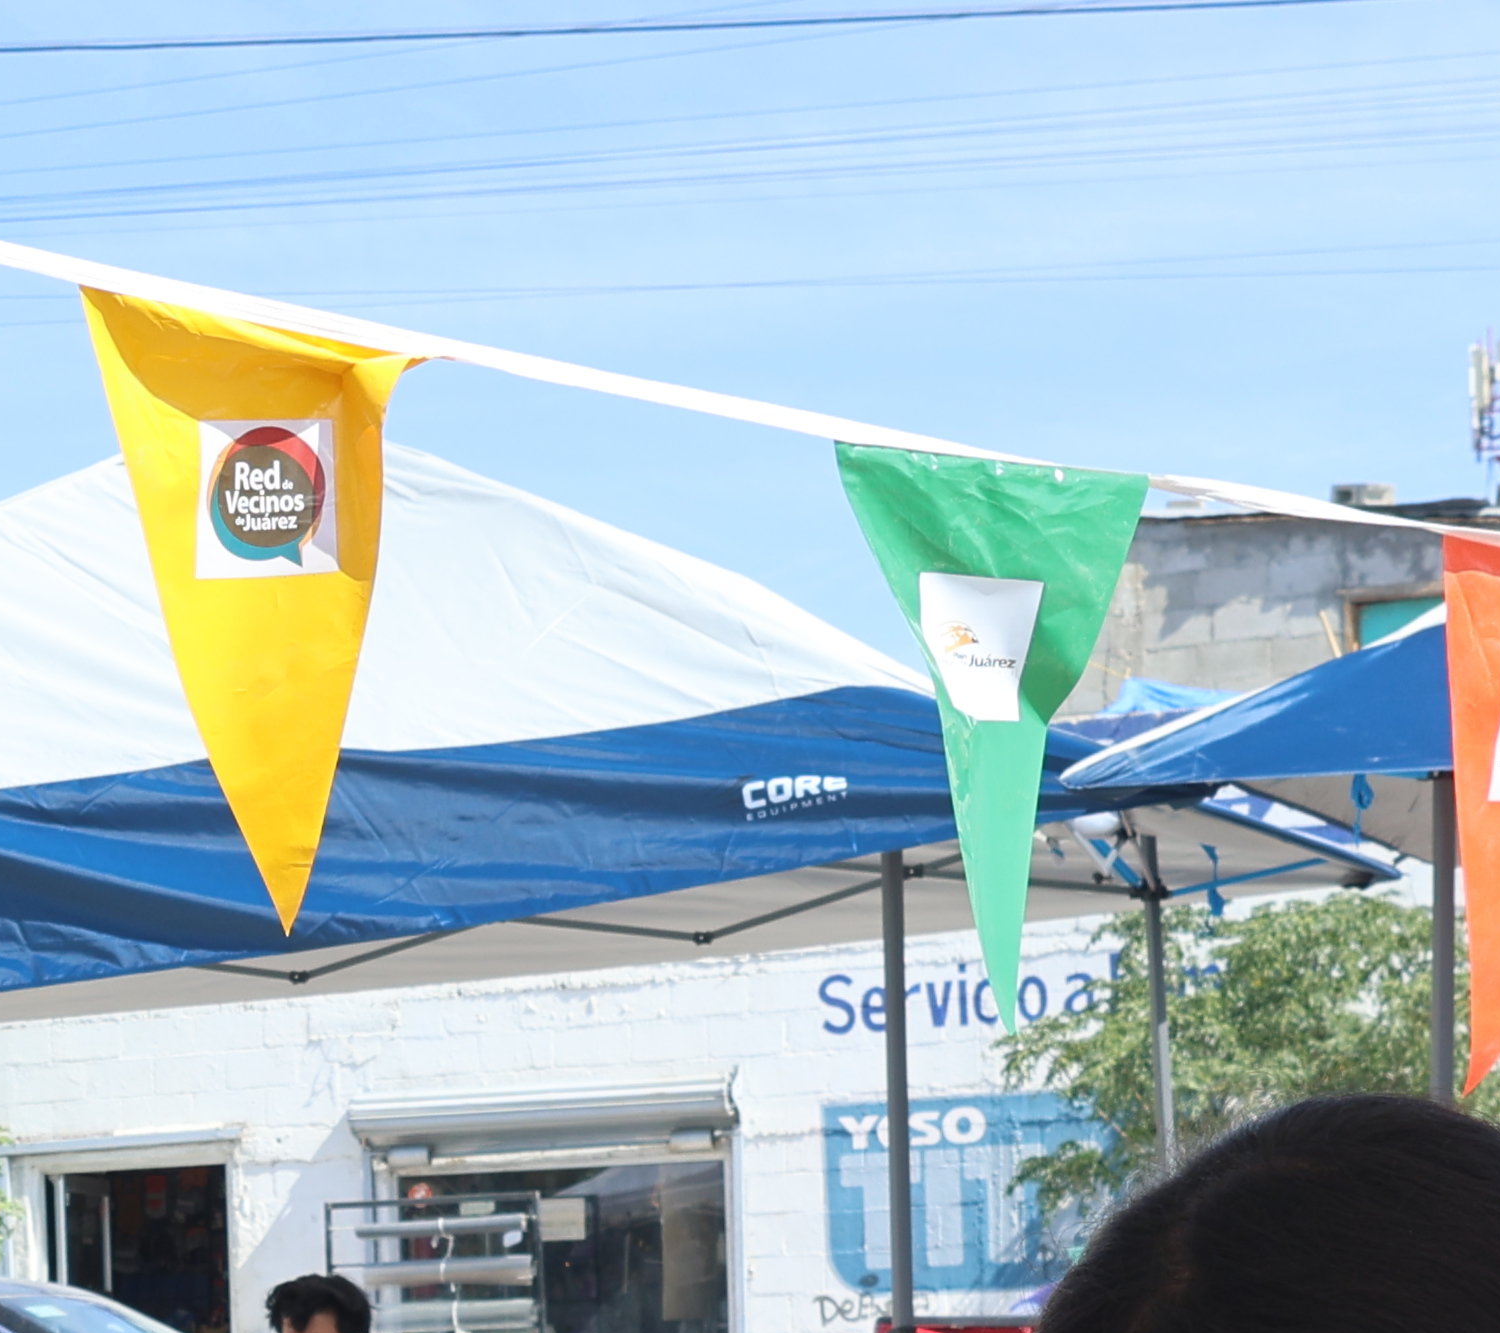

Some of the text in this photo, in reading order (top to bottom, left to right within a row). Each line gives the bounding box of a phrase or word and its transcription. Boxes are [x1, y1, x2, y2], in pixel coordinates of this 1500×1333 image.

[234, 460, 294, 490] Red de
[225, 490, 305, 514] Vecinos
[235, 512, 298, 531] de Juárez
[969, 654, 1017, 669] Juárez
[742, 775, 848, 809] CORE
[746, 792, 848, 821] EQUIPMENT
[818, 963, 1047, 1034] Sevico
